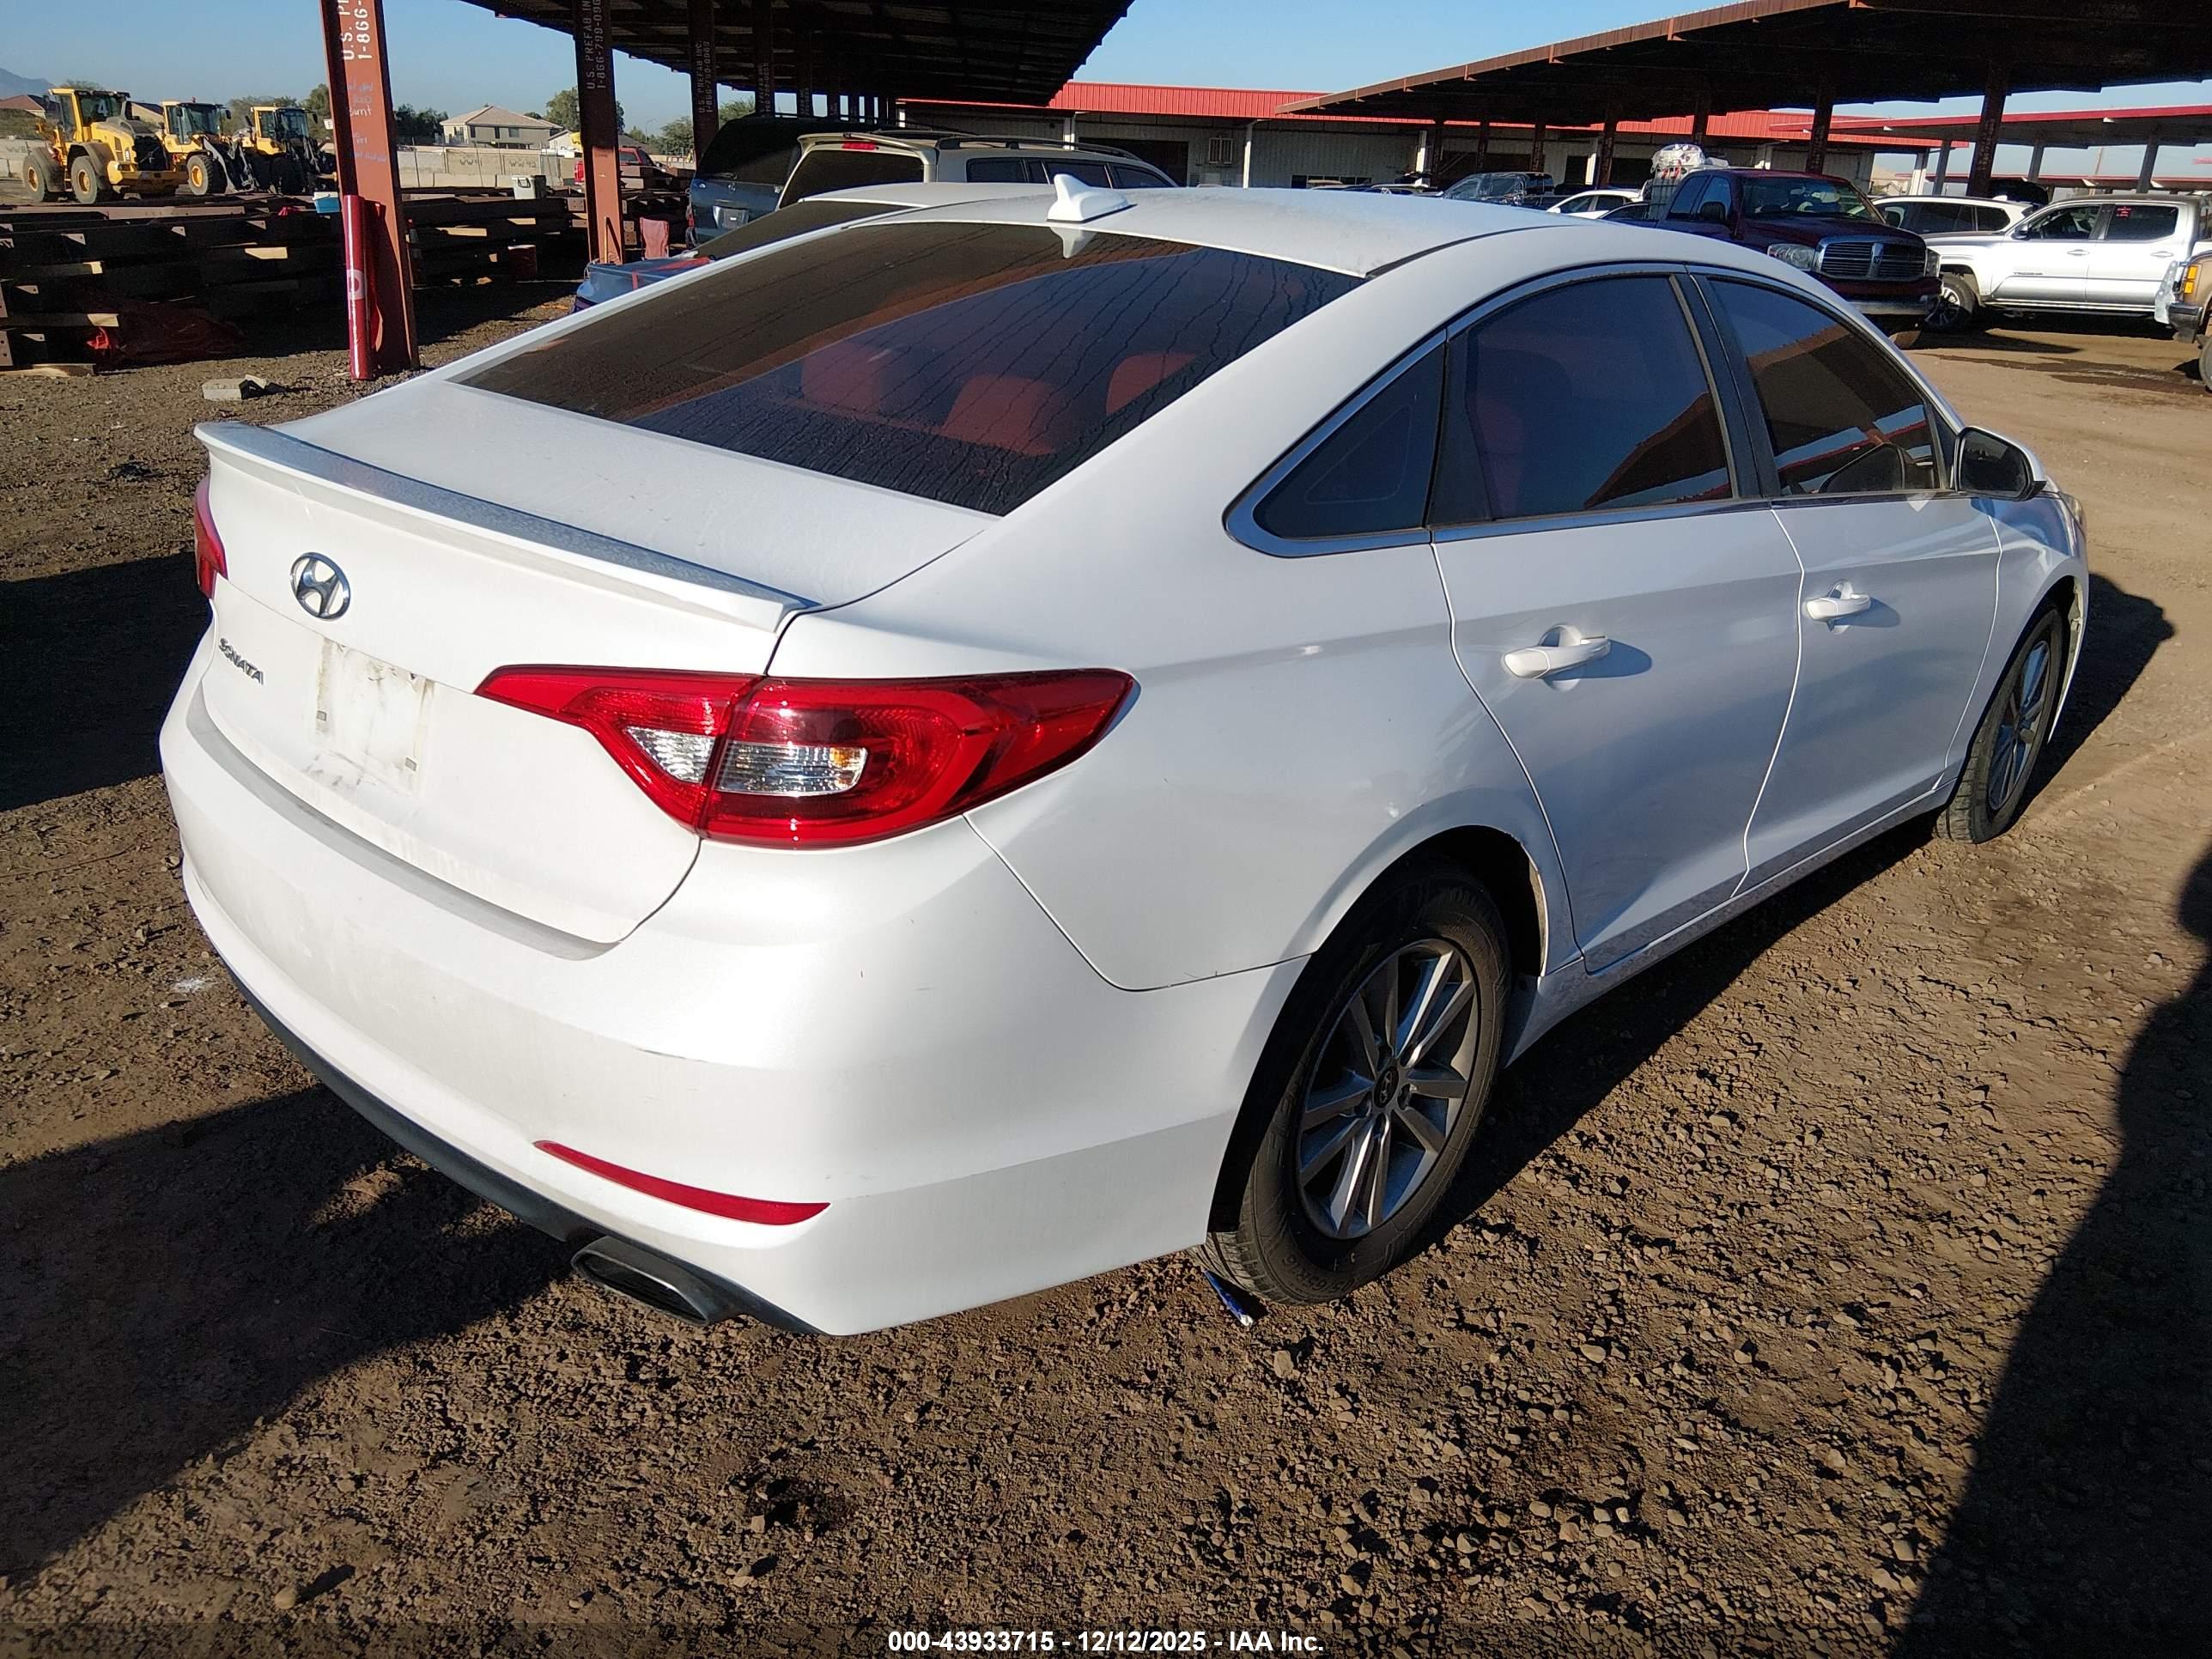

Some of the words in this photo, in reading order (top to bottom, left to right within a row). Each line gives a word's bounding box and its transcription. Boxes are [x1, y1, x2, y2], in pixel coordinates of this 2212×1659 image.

[340, 27, 355, 60] U.S.
[353, 0, 373, 59] 1-866-
[582, 17, 594, 62] PREFAB
[586, 68, 596, 89] U.S.
[97, 99, 108, 117] 4
[218, 637, 264, 685] SONATA
